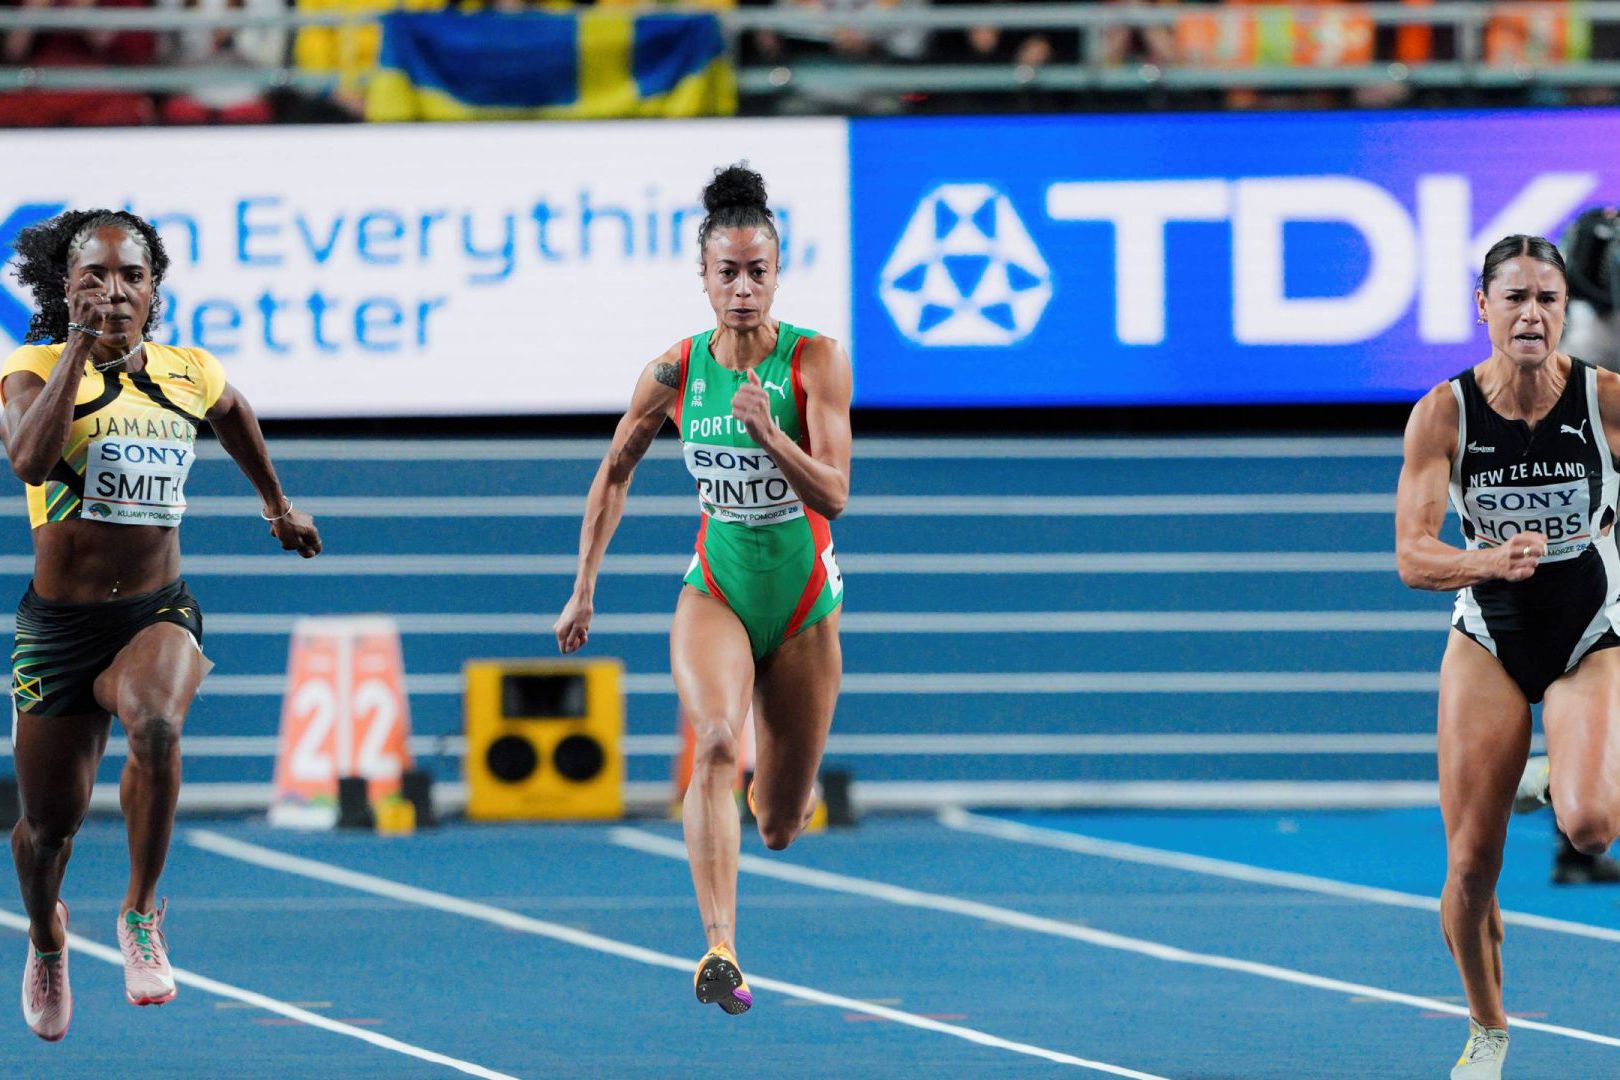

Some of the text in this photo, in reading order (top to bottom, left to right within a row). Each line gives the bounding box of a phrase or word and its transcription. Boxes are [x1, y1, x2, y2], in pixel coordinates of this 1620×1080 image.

[1047, 172, 1598, 345] TDK
[101, 443, 187, 466] SONY
[694, 449, 778, 471] SONY
[96, 471, 181, 501] SMITH
[1469, 462, 1585, 488] NEW ZEALAND
[1476, 489, 1578, 510] SONY
[290, 679, 336, 781] 2
[354, 679, 401, 780] 2
